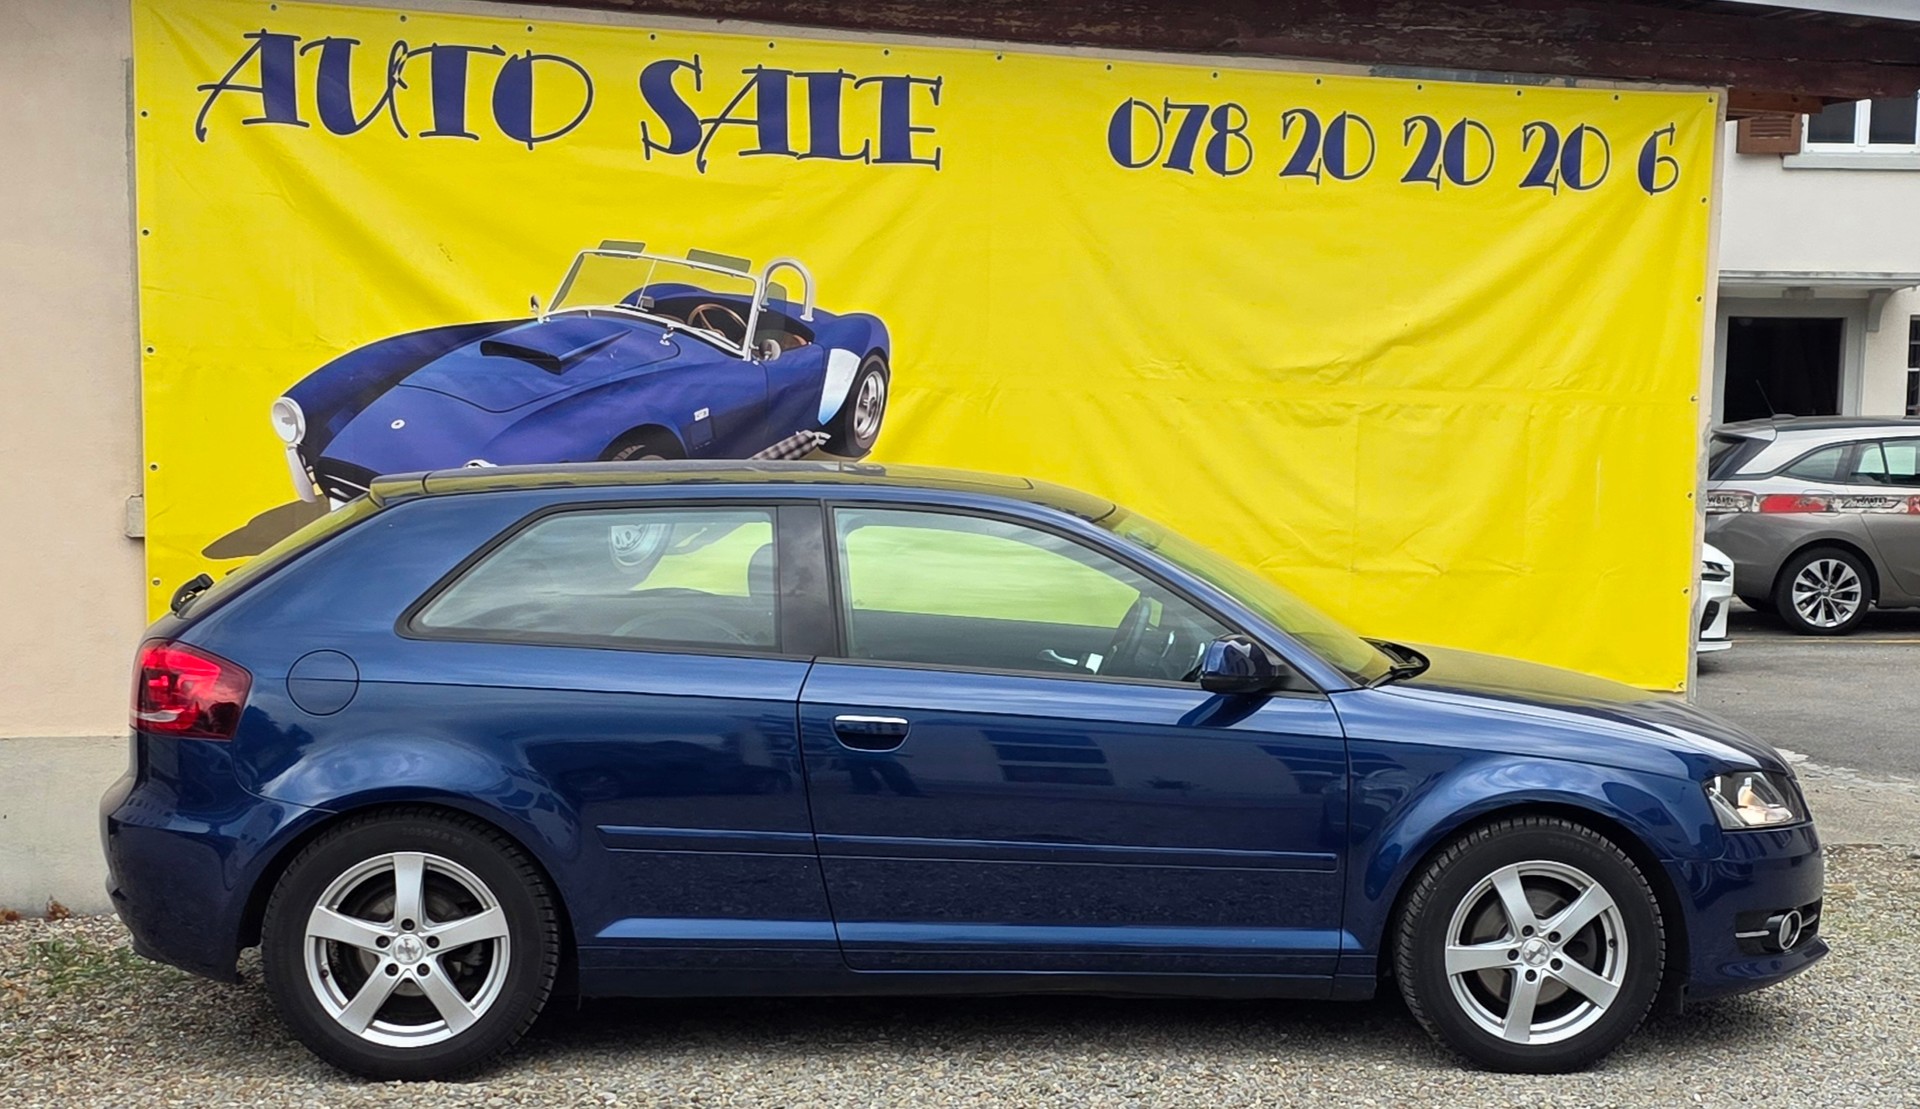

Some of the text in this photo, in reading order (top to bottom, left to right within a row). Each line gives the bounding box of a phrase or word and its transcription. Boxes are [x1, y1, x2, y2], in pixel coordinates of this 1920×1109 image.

[196, 27, 944, 174] AUTO SALE
[1107, 97, 1679, 196] 078 20 20 20 6
